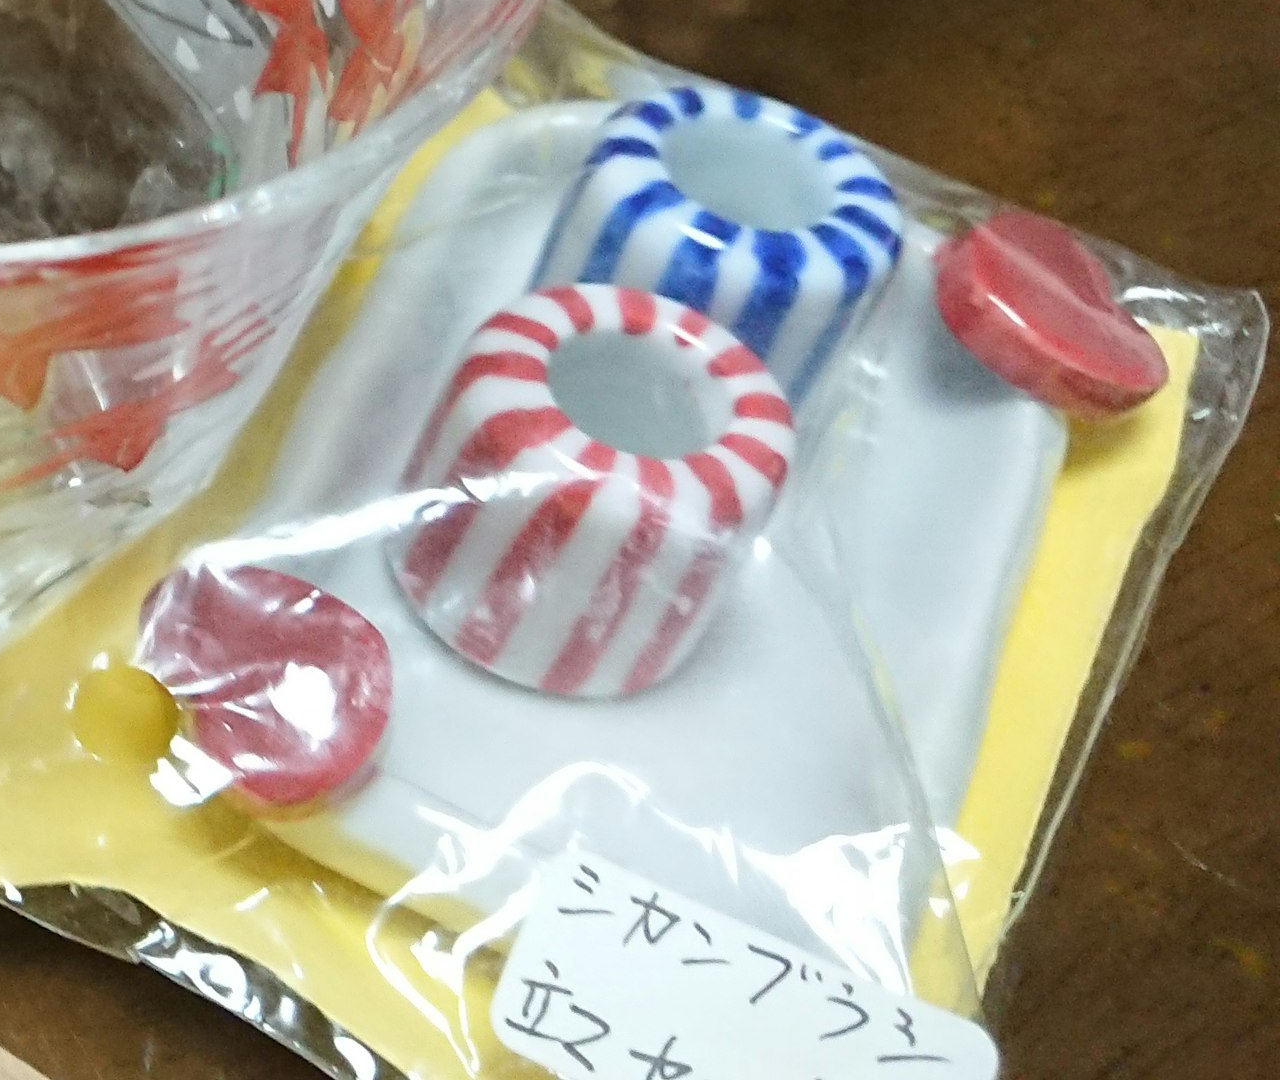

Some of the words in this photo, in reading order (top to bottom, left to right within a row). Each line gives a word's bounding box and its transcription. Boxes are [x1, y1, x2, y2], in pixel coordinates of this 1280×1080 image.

[556, 863, 952, 1063] シカンブラシ
